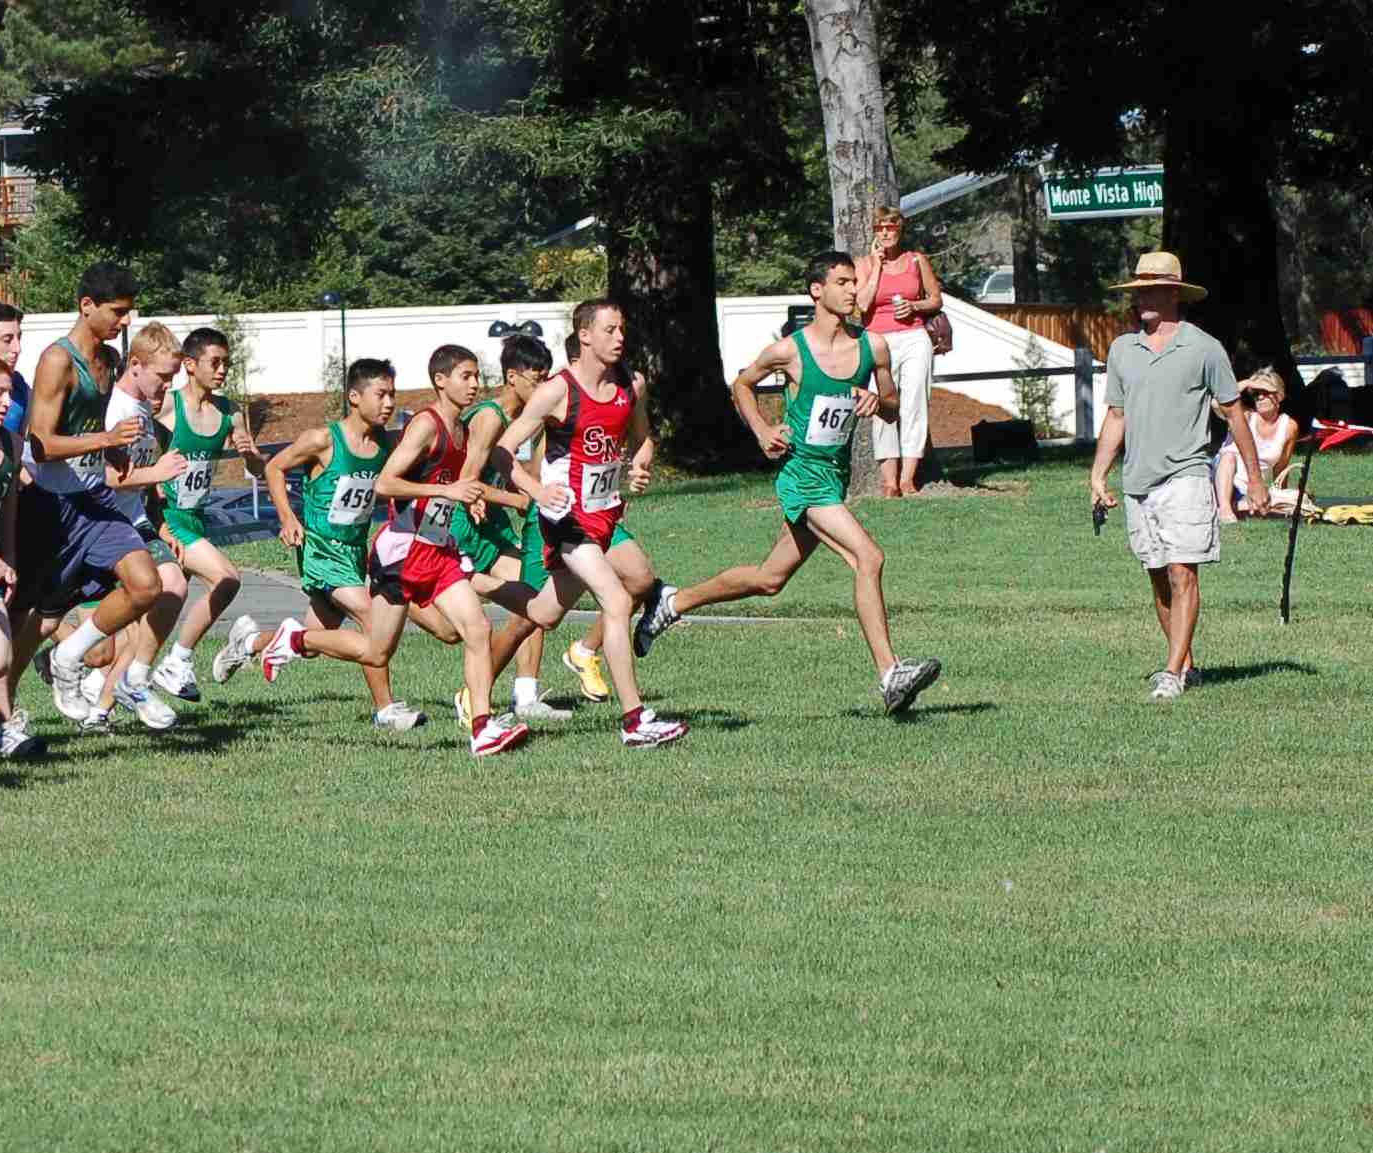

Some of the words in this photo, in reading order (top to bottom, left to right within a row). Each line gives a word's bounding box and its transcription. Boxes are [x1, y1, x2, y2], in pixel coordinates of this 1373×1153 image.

[1050, 184, 1091, 208] Monte
[1094, 182, 1130, 204] Vista
[1133, 181, 1163, 207] High
[818, 407, 854, 433] 467
[590, 467, 617, 496] 757
[340, 487, 374, 510] 459
